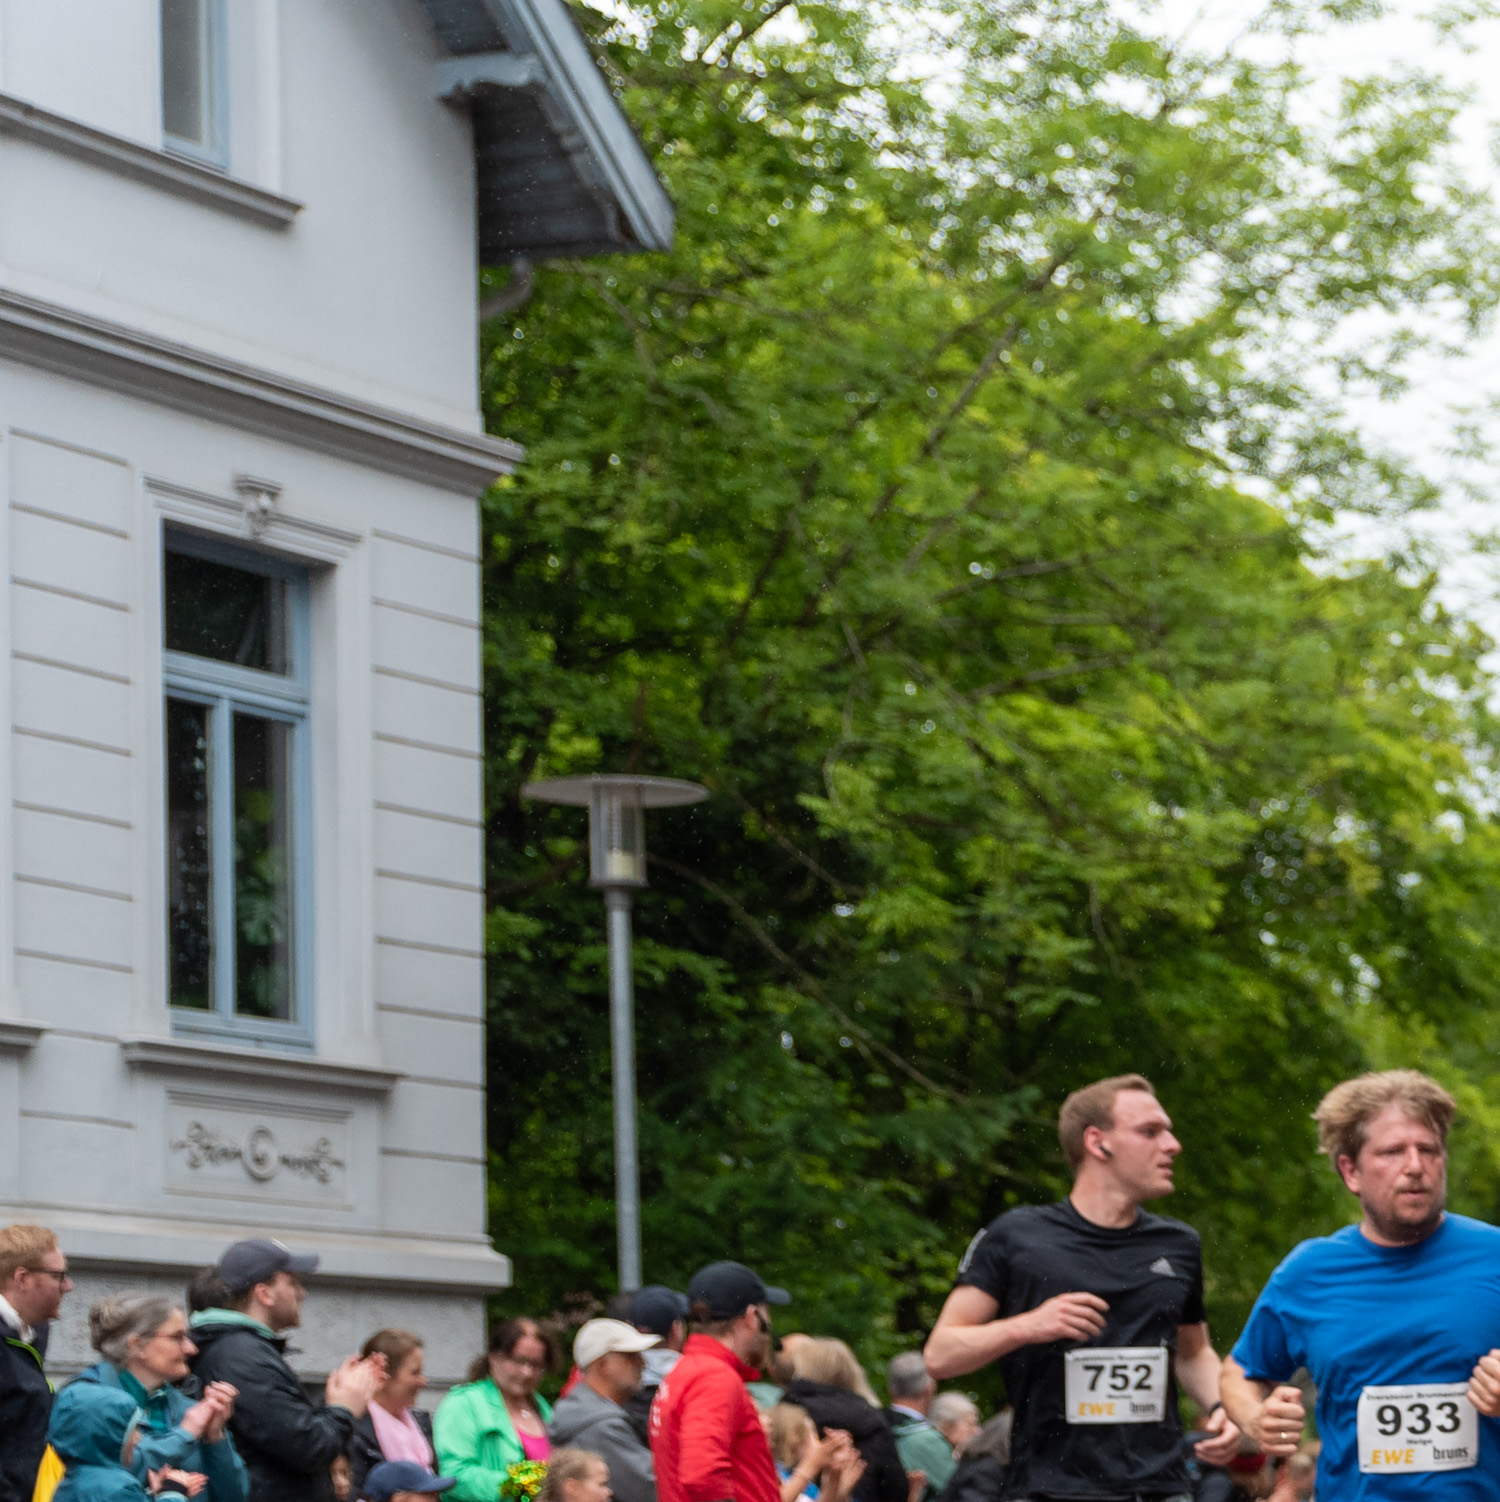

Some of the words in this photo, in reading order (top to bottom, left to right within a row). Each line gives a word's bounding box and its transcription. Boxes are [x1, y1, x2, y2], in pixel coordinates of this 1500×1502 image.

[1083, 1364, 1152, 1392] 752
[1377, 1401, 1461, 1436] 933
[1371, 1449, 1415, 1465] EWE
[1433, 1446, 1469, 1460] bruns
